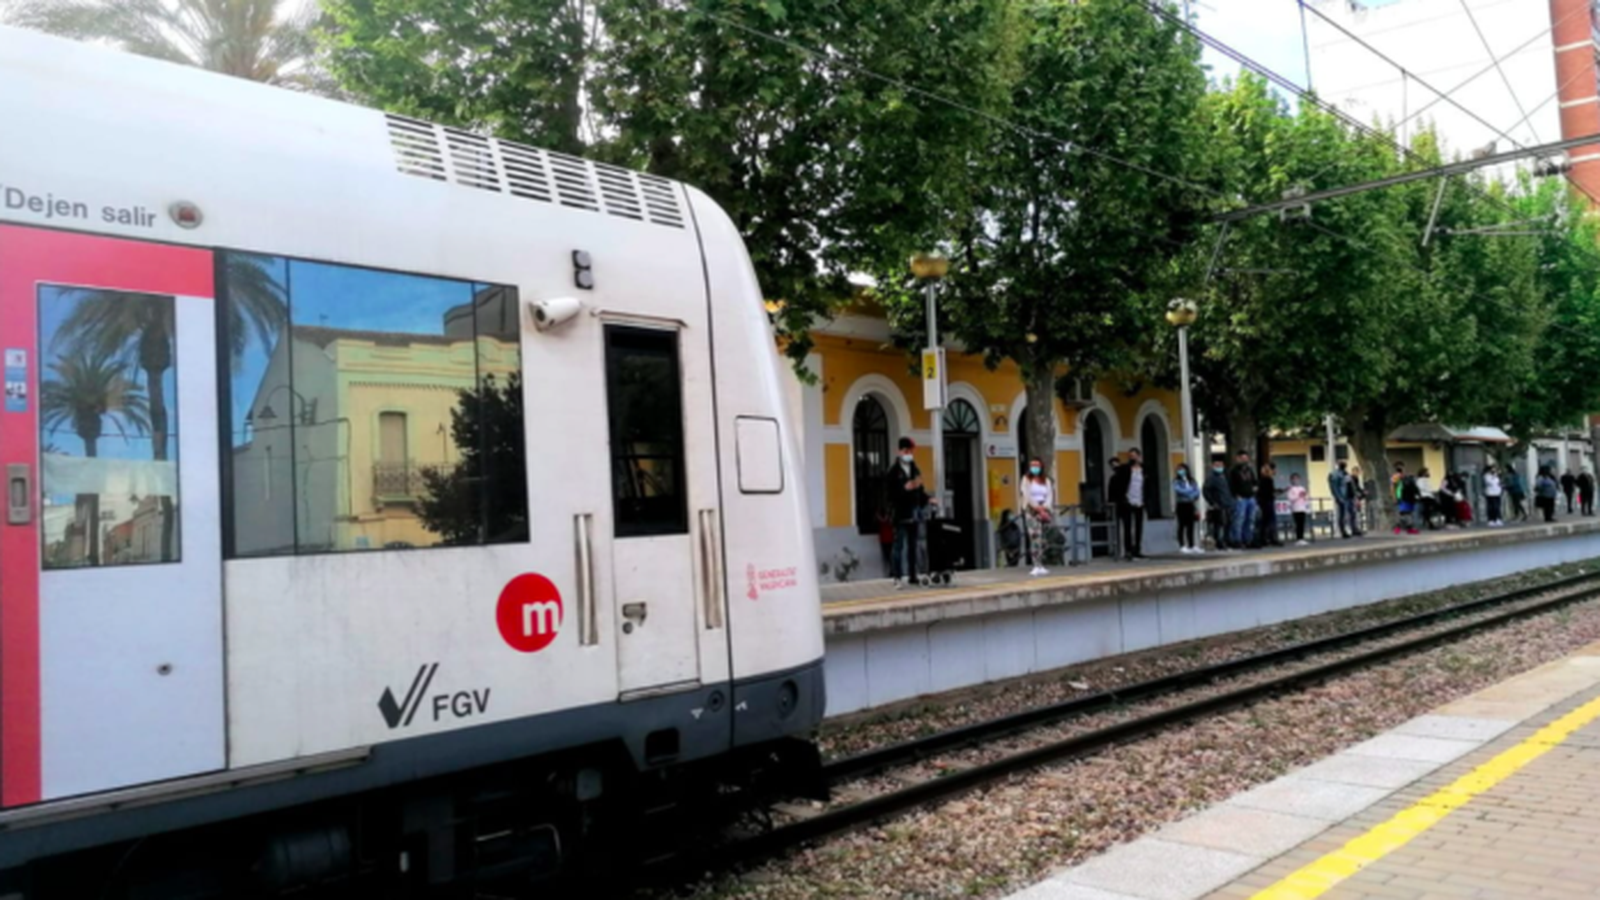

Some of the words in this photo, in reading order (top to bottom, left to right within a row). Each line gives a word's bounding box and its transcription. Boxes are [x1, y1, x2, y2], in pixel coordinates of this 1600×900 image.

[101, 205, 156, 227] salir
[926, 366, 935, 379] 2
[522, 600, 560, 636] m
[432, 687, 490, 721] FGV
